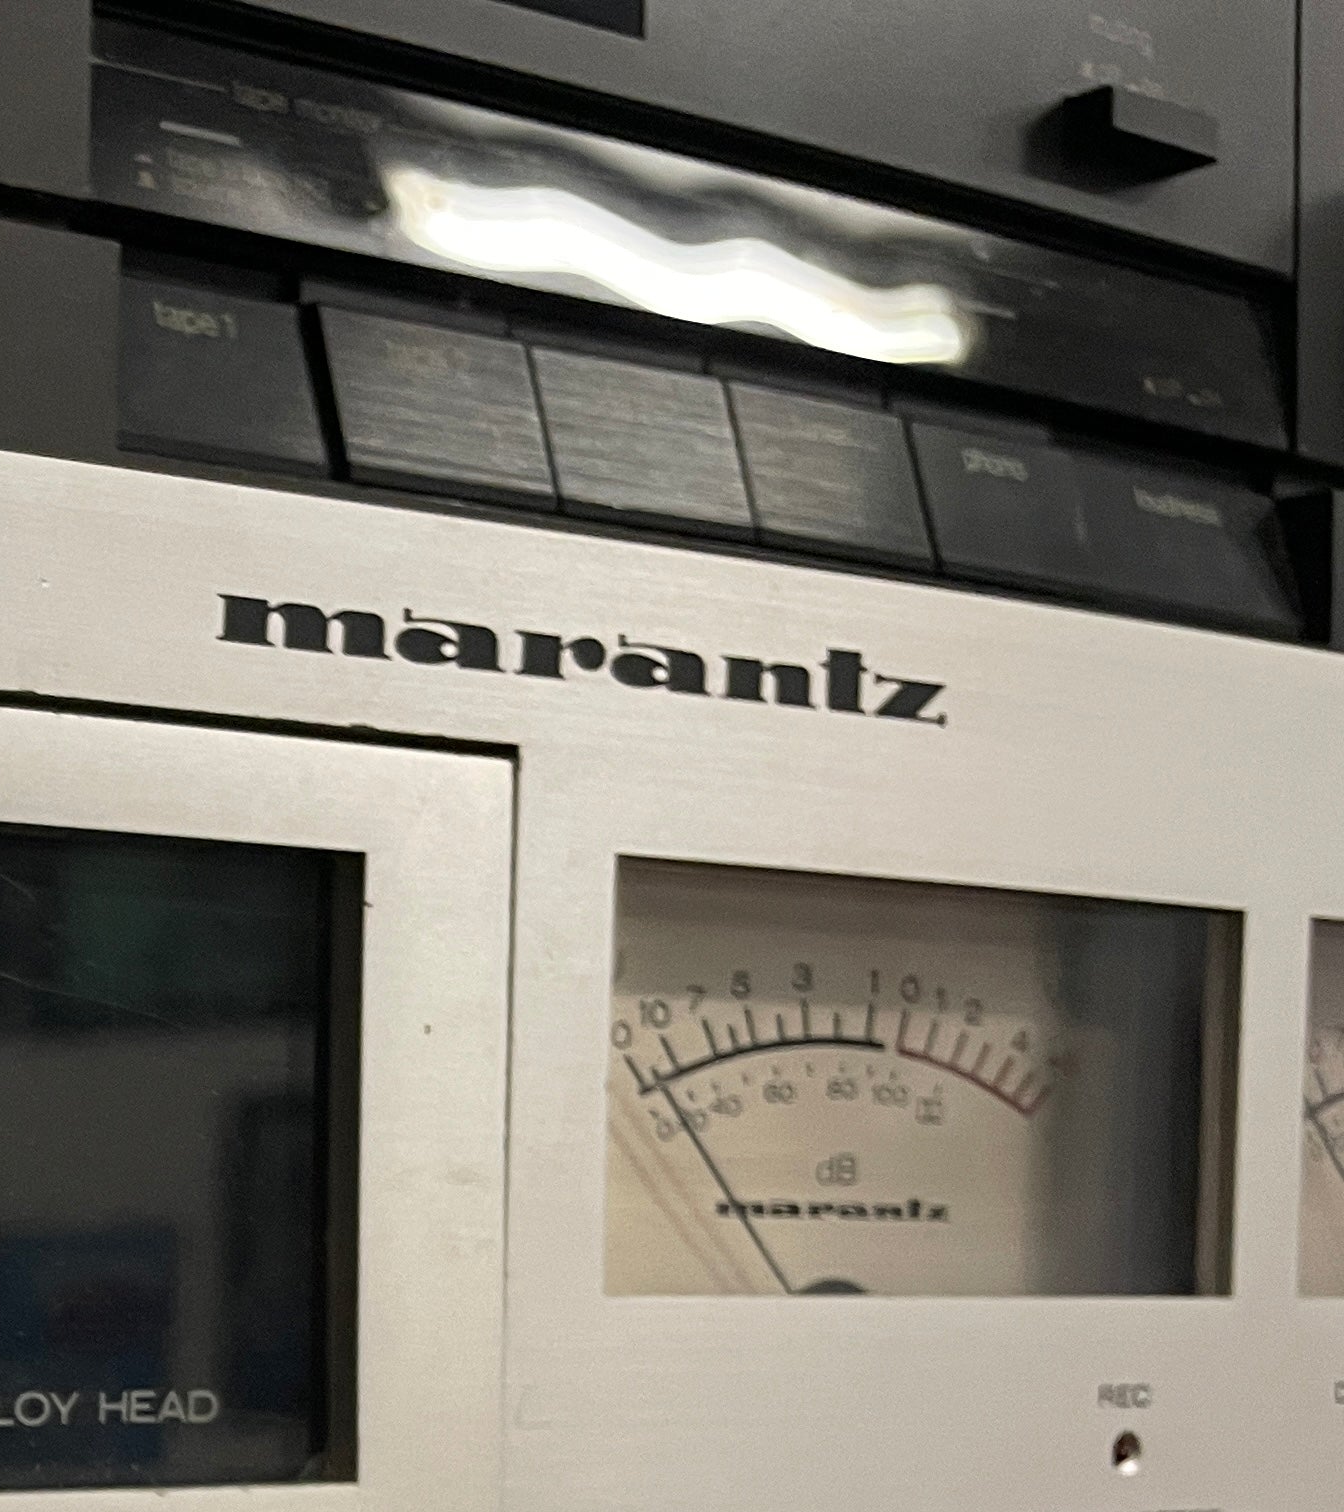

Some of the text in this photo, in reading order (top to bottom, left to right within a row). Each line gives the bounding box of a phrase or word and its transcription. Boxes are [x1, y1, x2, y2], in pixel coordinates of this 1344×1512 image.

[153, 301, 218, 337] tape
[215, 592, 949, 728] marantz
[870, 968, 881, 996] 1
[899, 972, 920, 1004] 0
[815, 1151, 858, 1187] dB
[714, 1197, 950, 1223] marantz
[97, 1388, 221, 1426] HEAD
